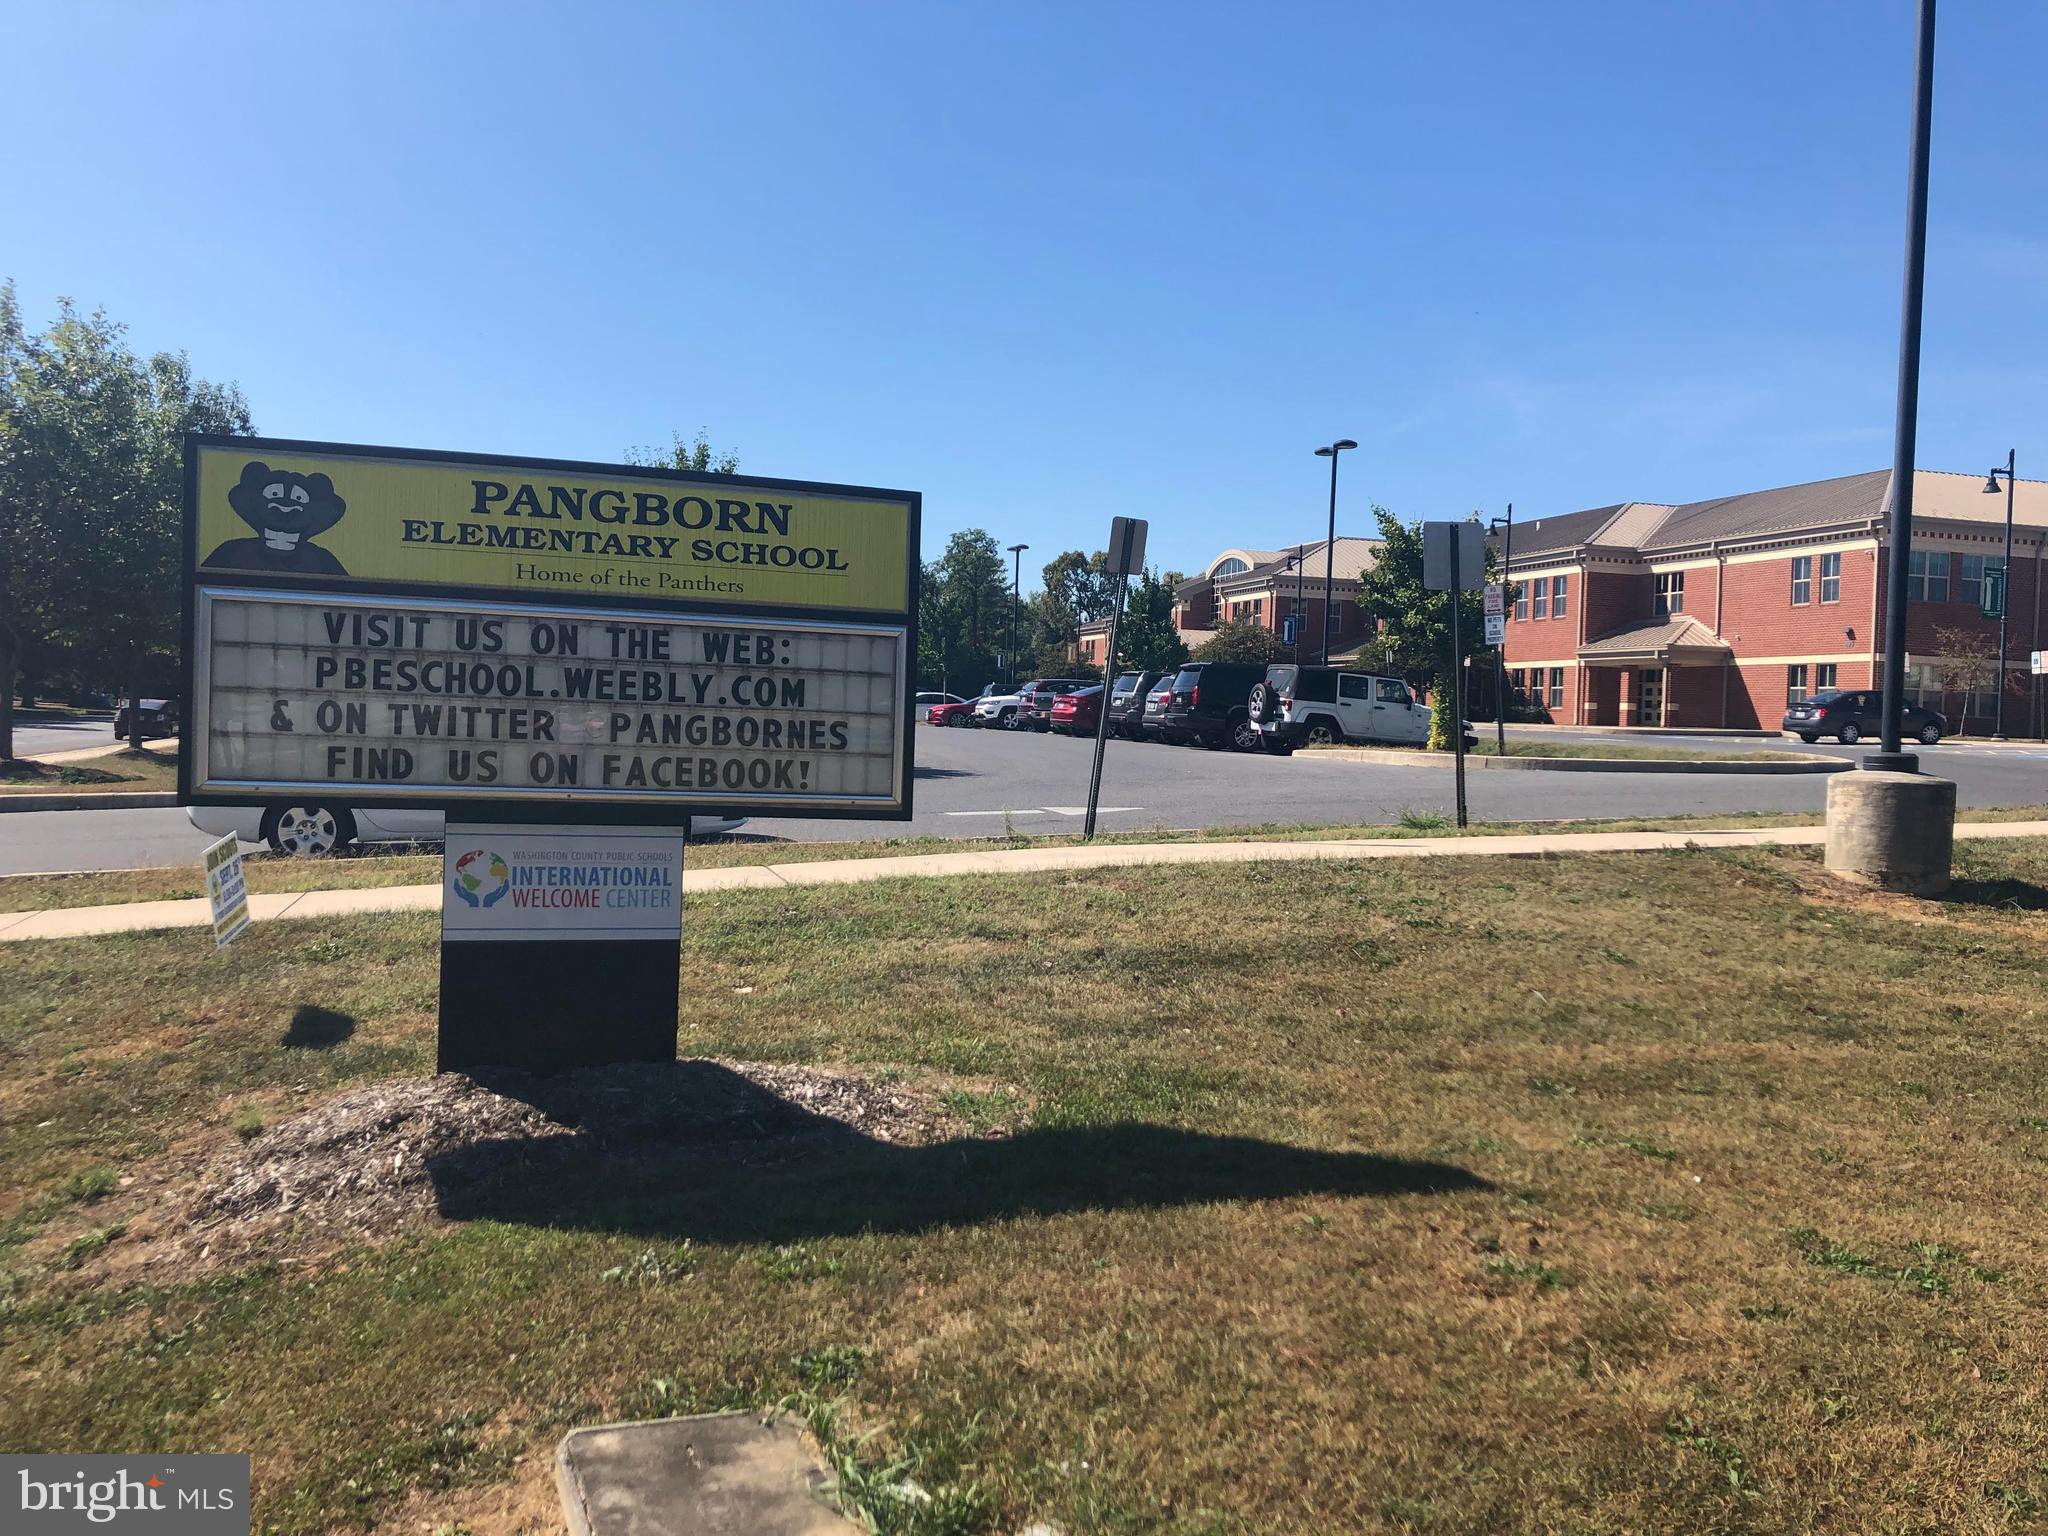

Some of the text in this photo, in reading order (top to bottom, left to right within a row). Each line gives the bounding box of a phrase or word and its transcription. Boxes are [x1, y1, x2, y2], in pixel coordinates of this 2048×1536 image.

[470, 480, 793, 536] PANGBORN
[401, 519, 849, 571] ELEMENTARY SCHOOL
[515, 563, 745, 594] Home of the Panthers
[323, 612, 791, 665] VISIT US ON THE WEB:
[315, 656, 805, 707] PBESCHOOL.WEEBLY.COM
[270, 700, 848, 750] & ON TWITTER PANGBORNES
[327, 746, 810, 790] FIND US ON FACEBOOK!
[512, 850, 673, 862] WASHINGTON COUNTY PUBLIC SCHOOLS
[512, 866, 673, 887] INTERNATIONAL
[512, 888, 671, 908] WELCOME CENTER
